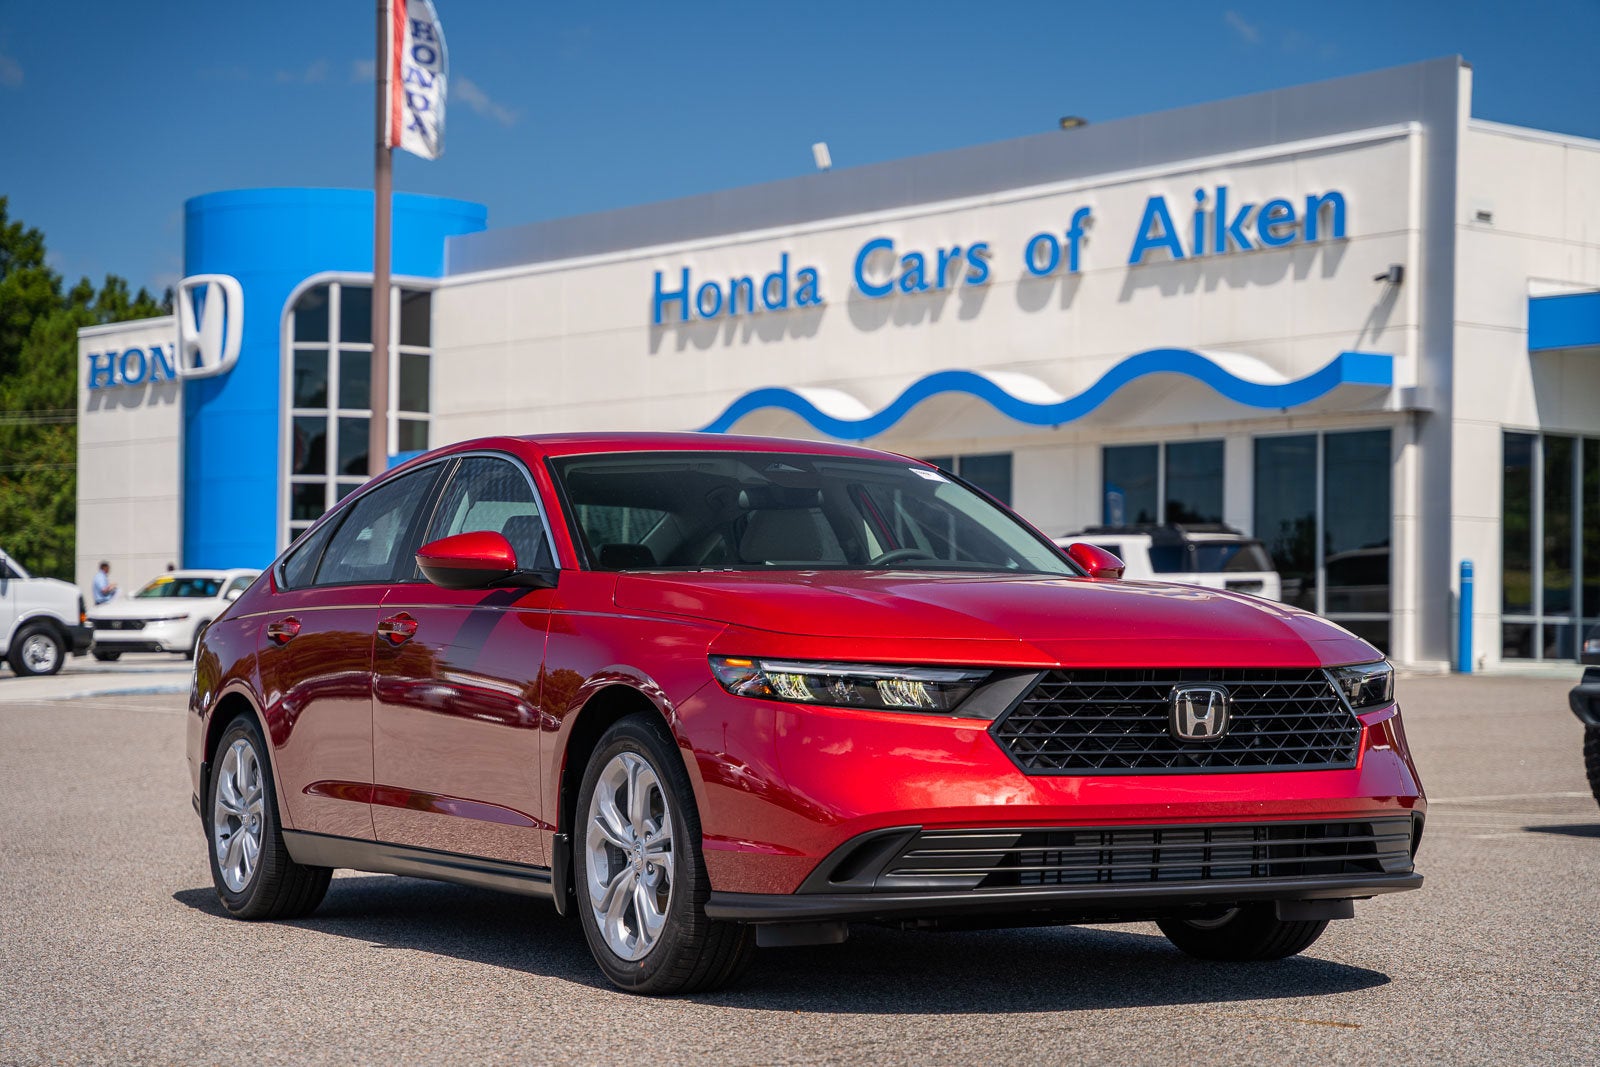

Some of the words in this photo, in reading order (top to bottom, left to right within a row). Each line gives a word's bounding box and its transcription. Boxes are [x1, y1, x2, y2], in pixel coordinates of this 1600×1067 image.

[652, 252, 823, 325] Honda
[853, 237, 991, 299] Cars
[1024, 206, 1092, 277] of
[1127, 184, 1347, 265] Aiken
